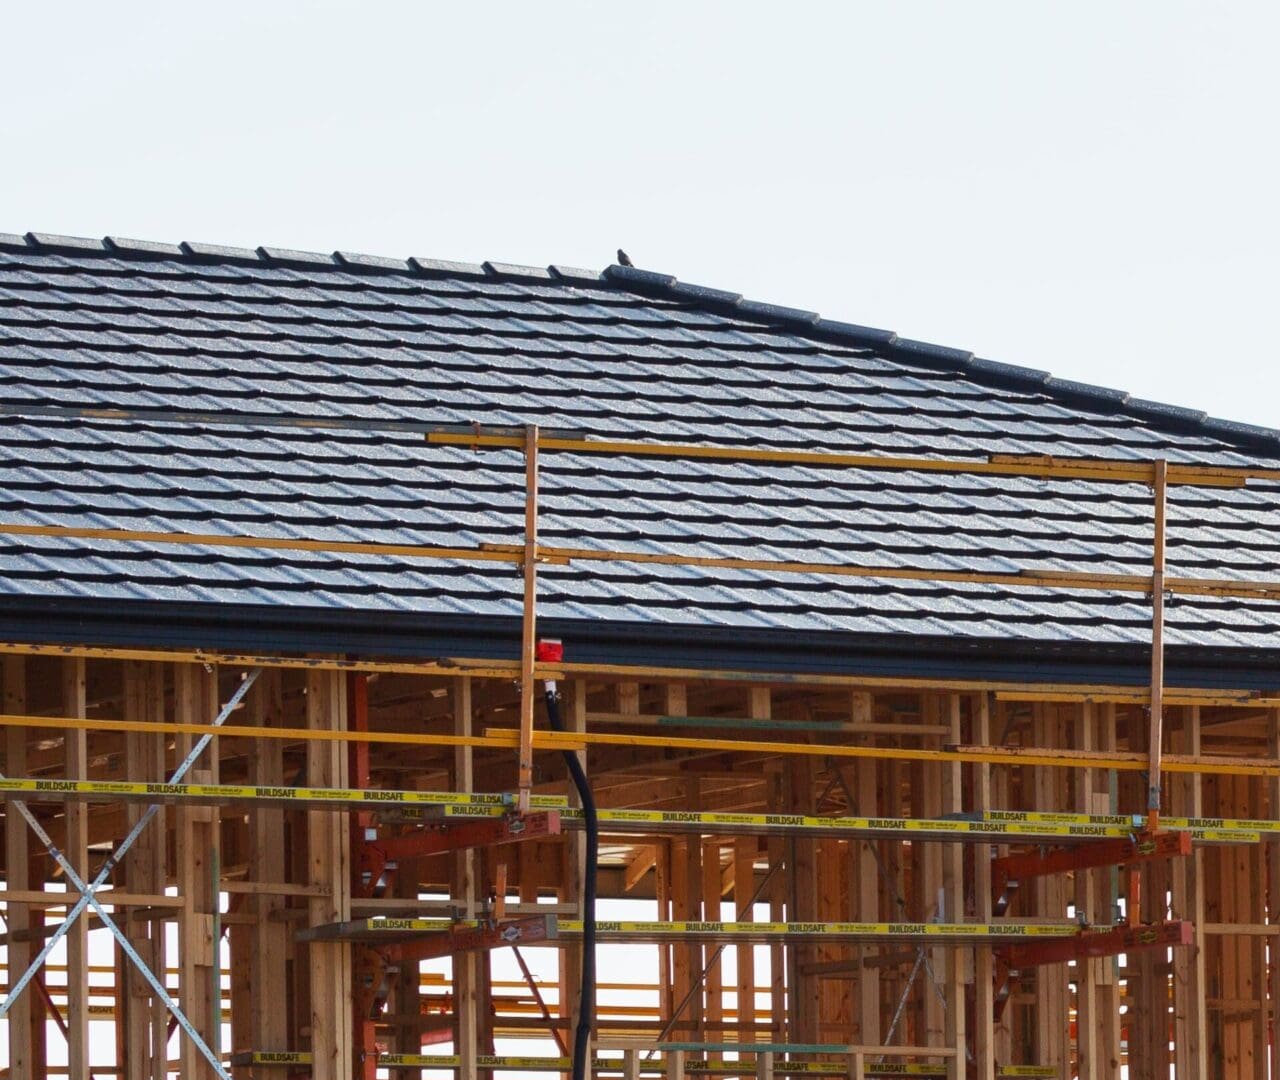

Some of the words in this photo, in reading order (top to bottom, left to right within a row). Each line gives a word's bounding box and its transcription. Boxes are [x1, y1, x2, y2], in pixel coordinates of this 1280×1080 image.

[36, 781, 78, 791] BUILDSAFE
[146, 784, 188, 794] BUILDSAFE
[256, 788, 296, 798] BUILDSAFE
[363, 791, 403, 801] BUILDSAFE
[470, 794, 504, 804] BUILDSA
[452, 806, 492, 816] BUILDSAFE
[662, 812, 702, 822] BUILDSAFE
[765, 815, 805, 825] BUILDSAFE
[868, 819, 906, 829] BUILDSAFE
[968, 823, 1007, 832] BUILDSAFE
[1069, 826, 1107, 836] BUILDSAFE
[990, 811, 1028, 821] BUILDSAFE
[1089, 815, 1126, 825] BUILDSAFE
[1187, 819, 1224, 828] BUILDSAFE
[372, 920, 412, 929] BUILDSAFE
[596, 922, 622, 931] LDSAFE
[685, 922, 724, 931] BUILDSAFE
[788, 923, 826, 932] BUILDSAFE
[888, 924, 927, 933] BUILDSAFE
[988, 926, 1026, 934] BUILDSAFE
[870, 1064, 907, 1073] BUILDSAFE
